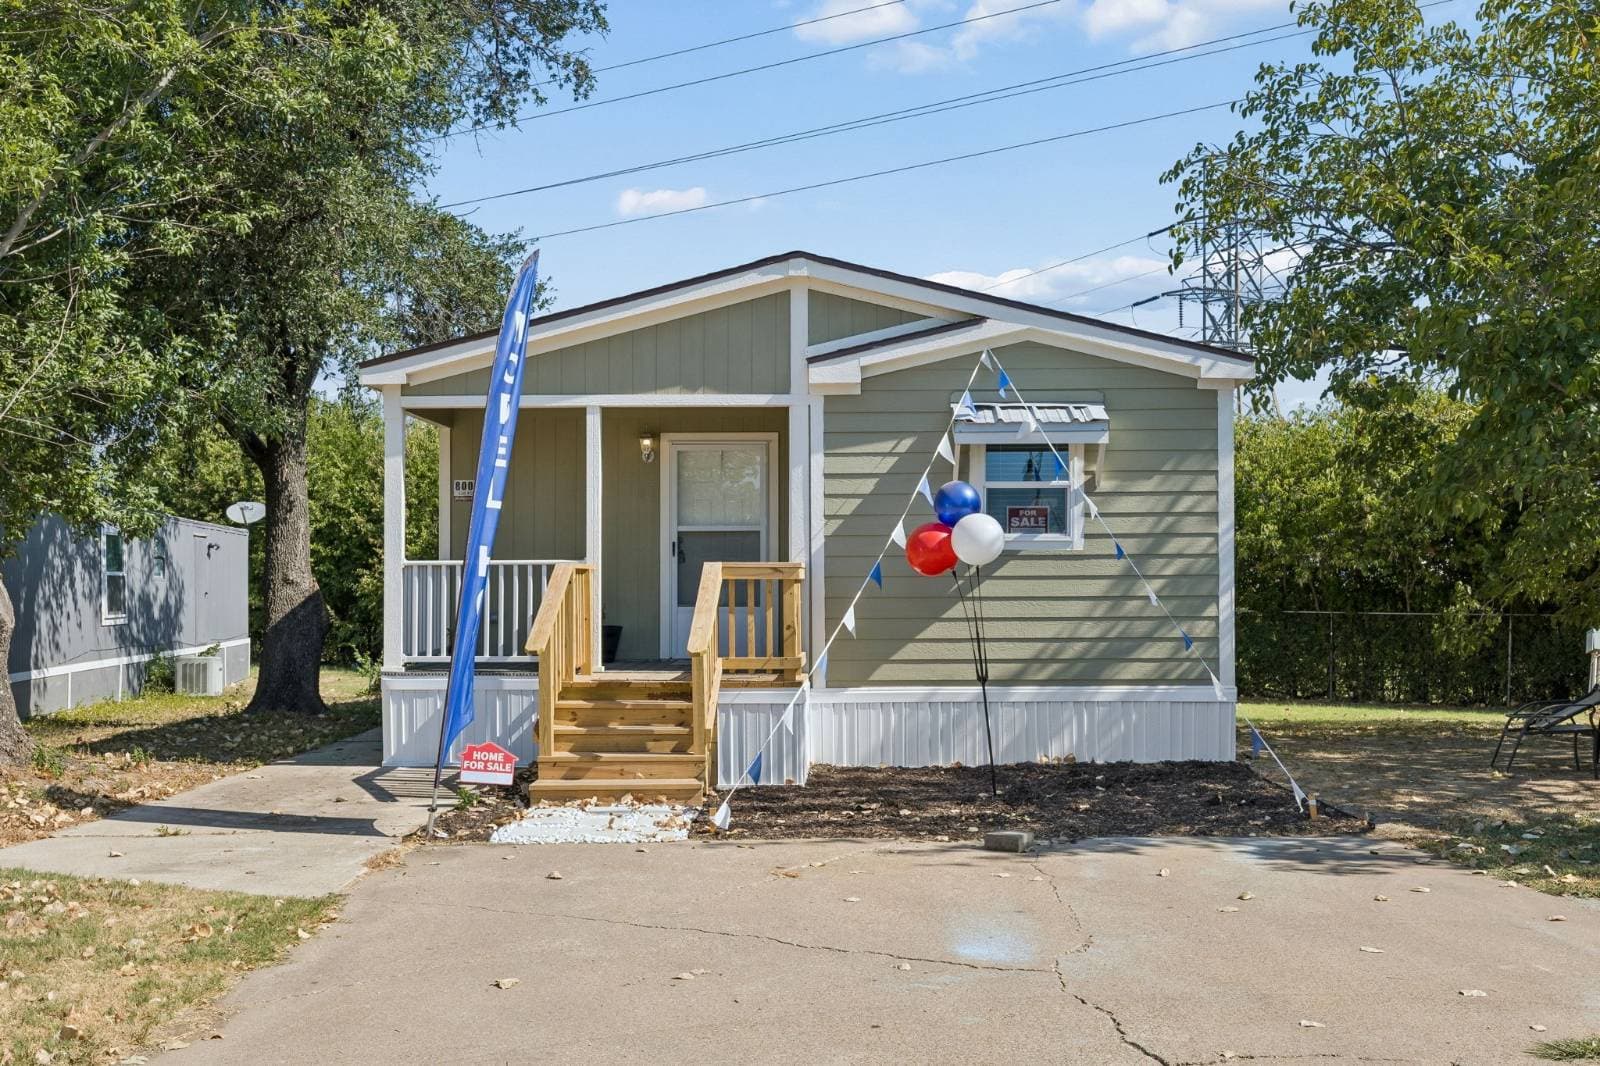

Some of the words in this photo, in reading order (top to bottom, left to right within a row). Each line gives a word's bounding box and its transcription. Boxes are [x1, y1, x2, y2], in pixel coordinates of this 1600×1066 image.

[455, 481, 473, 491] 800
[1010, 517, 1046, 527] SALE
[472, 751, 505, 762] HOME
[463, 760, 484, 770] FOR
[486, 762, 512, 772] SALE
